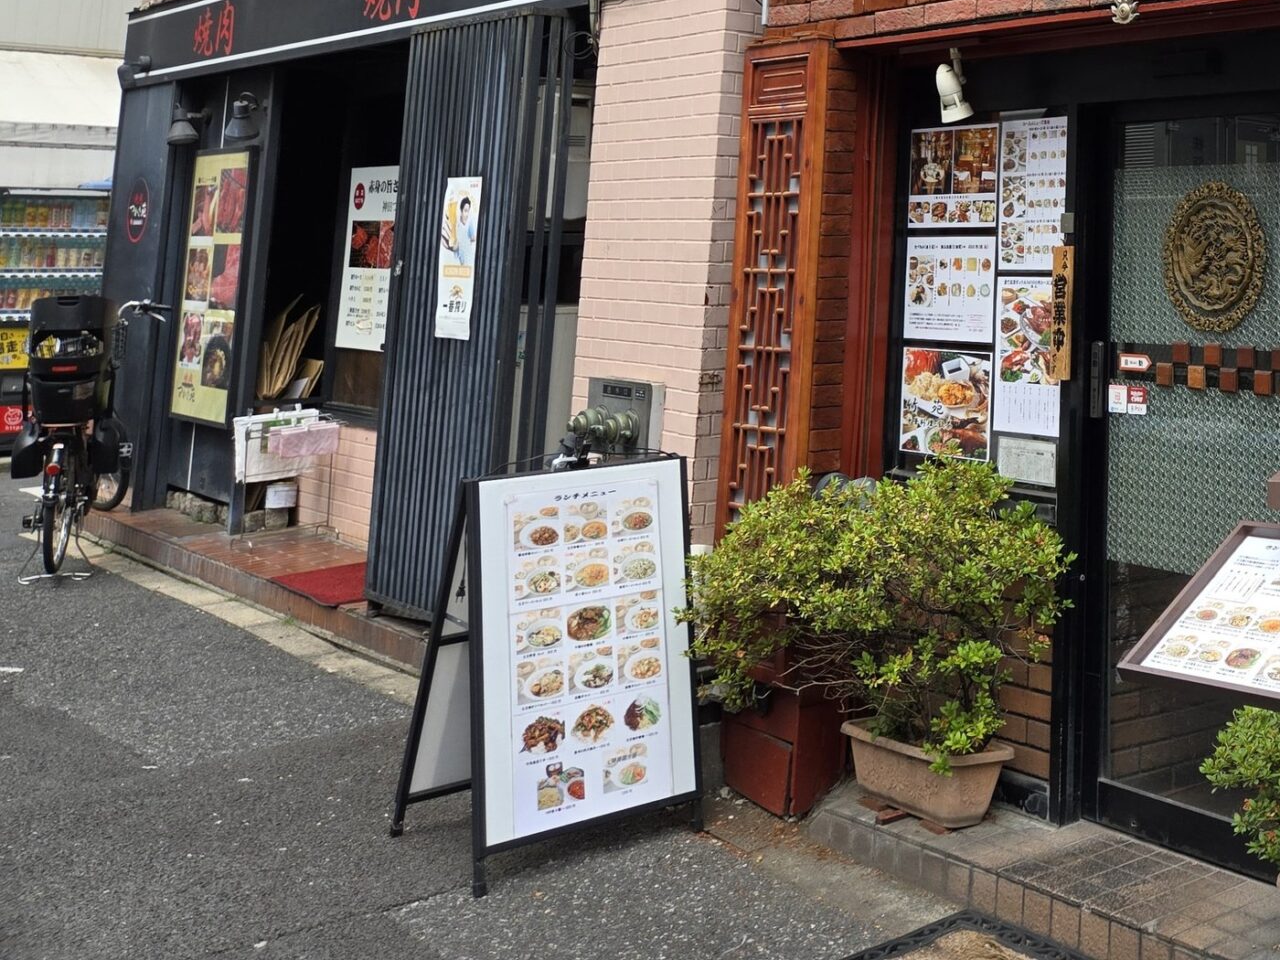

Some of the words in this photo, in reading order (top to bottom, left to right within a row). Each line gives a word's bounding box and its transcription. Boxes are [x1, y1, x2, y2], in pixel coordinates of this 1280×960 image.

[193, 0, 235, 57] 焼肉
[443, 300, 467, 314] 一番搾り
[554, 489, 617, 502] ランチメニュー
